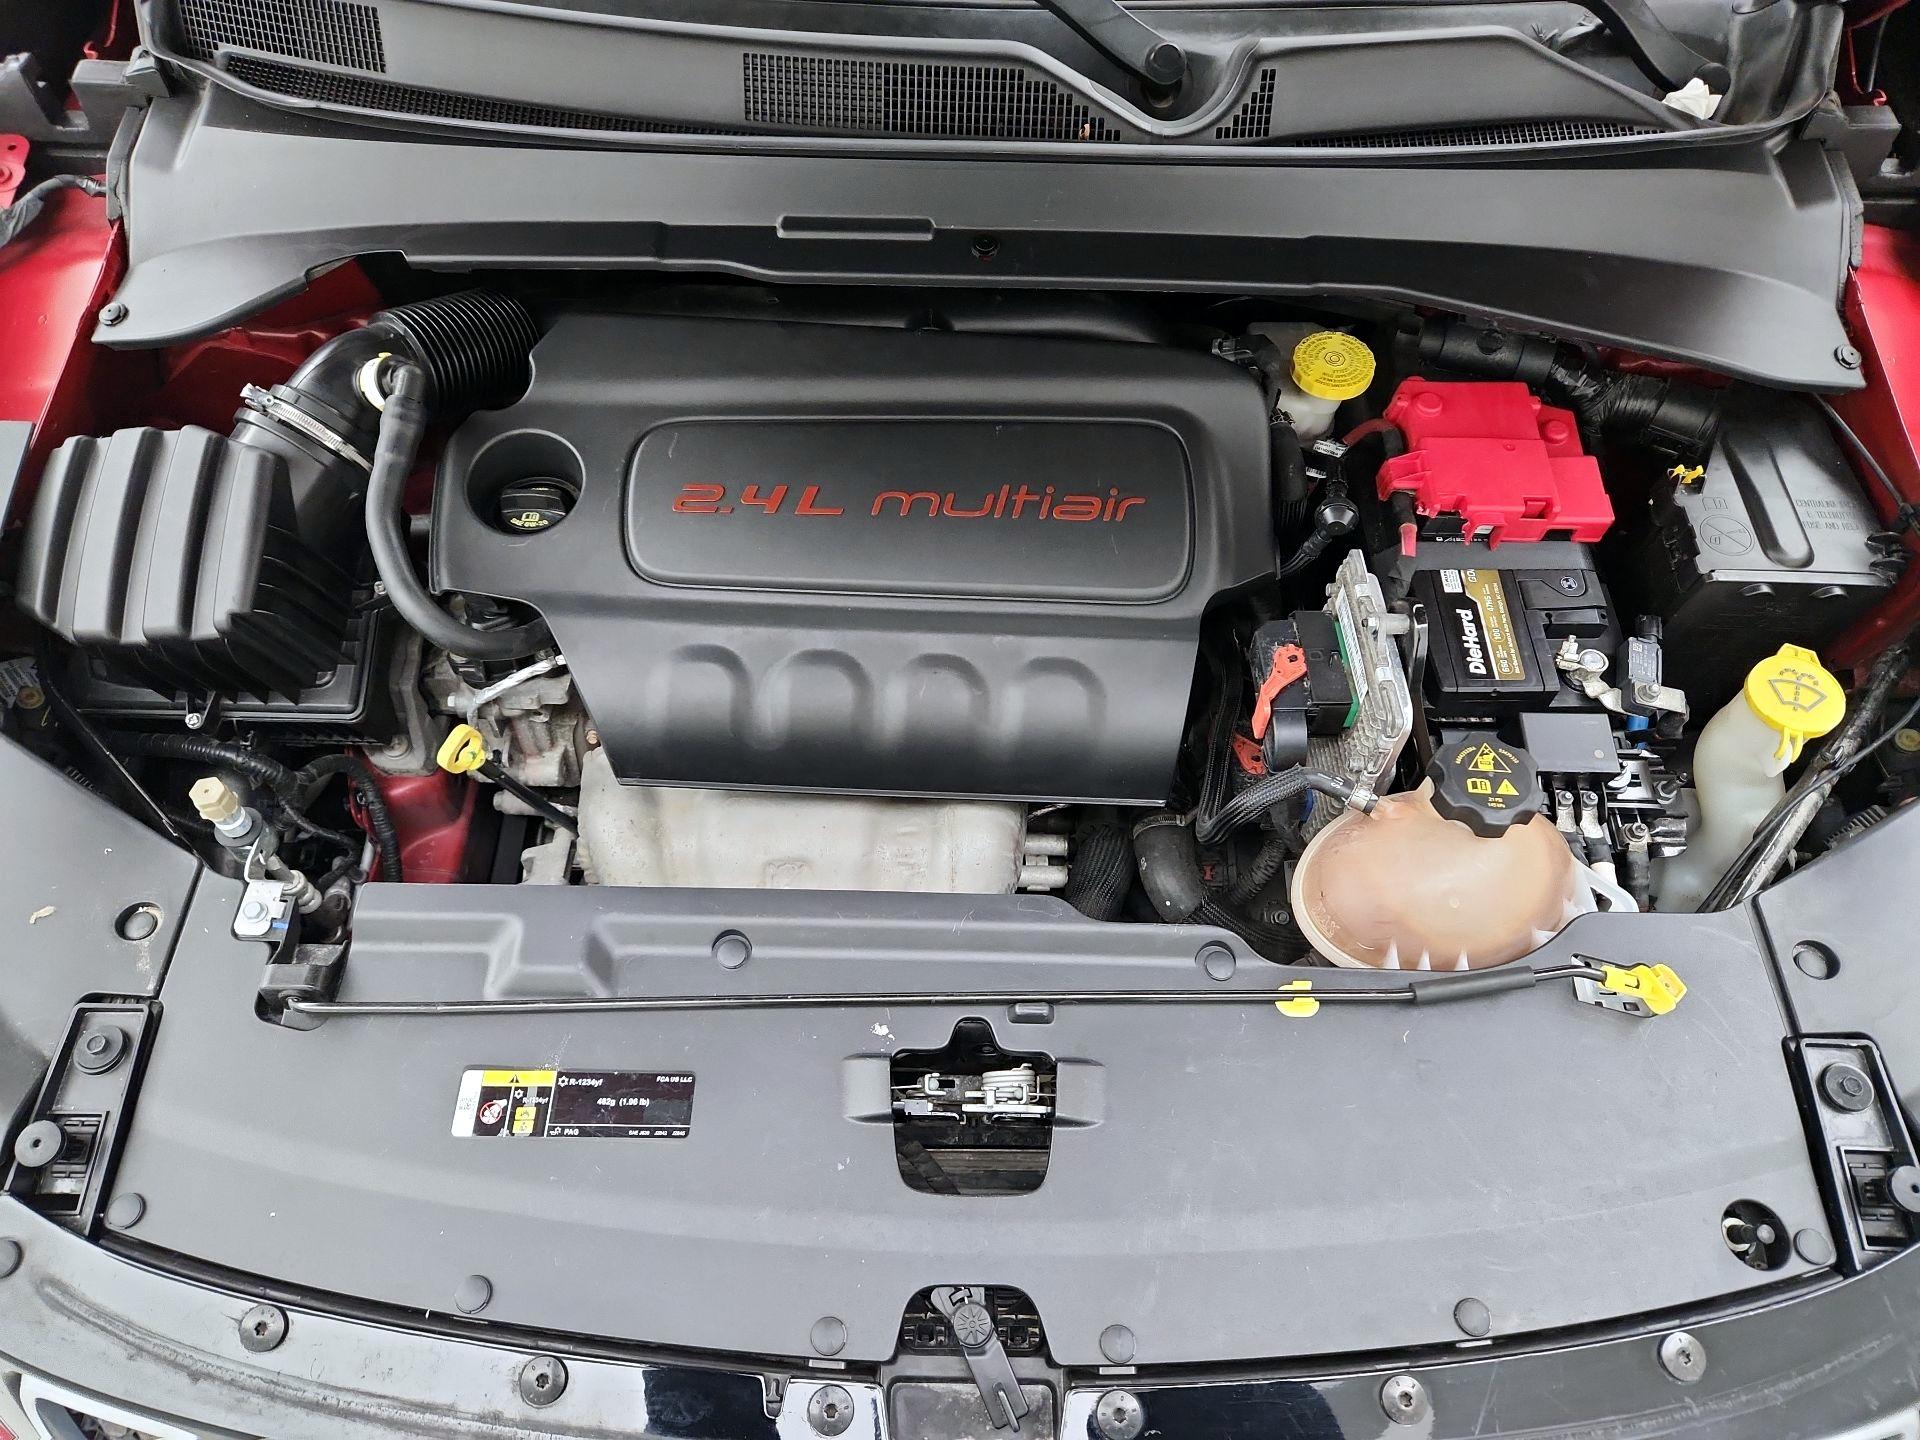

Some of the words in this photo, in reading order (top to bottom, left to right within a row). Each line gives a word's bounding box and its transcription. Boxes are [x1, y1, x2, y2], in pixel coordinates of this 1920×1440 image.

[672, 484, 844, 514] 2.4L
[870, 484, 1146, 522] multiair
[1493, 629, 1502, 640] 100
[1455, 608, 1487, 674] DieHard
[569, 1078, 603, 1087] R-1234yf
[564, 1128, 579, 1136] PAG
